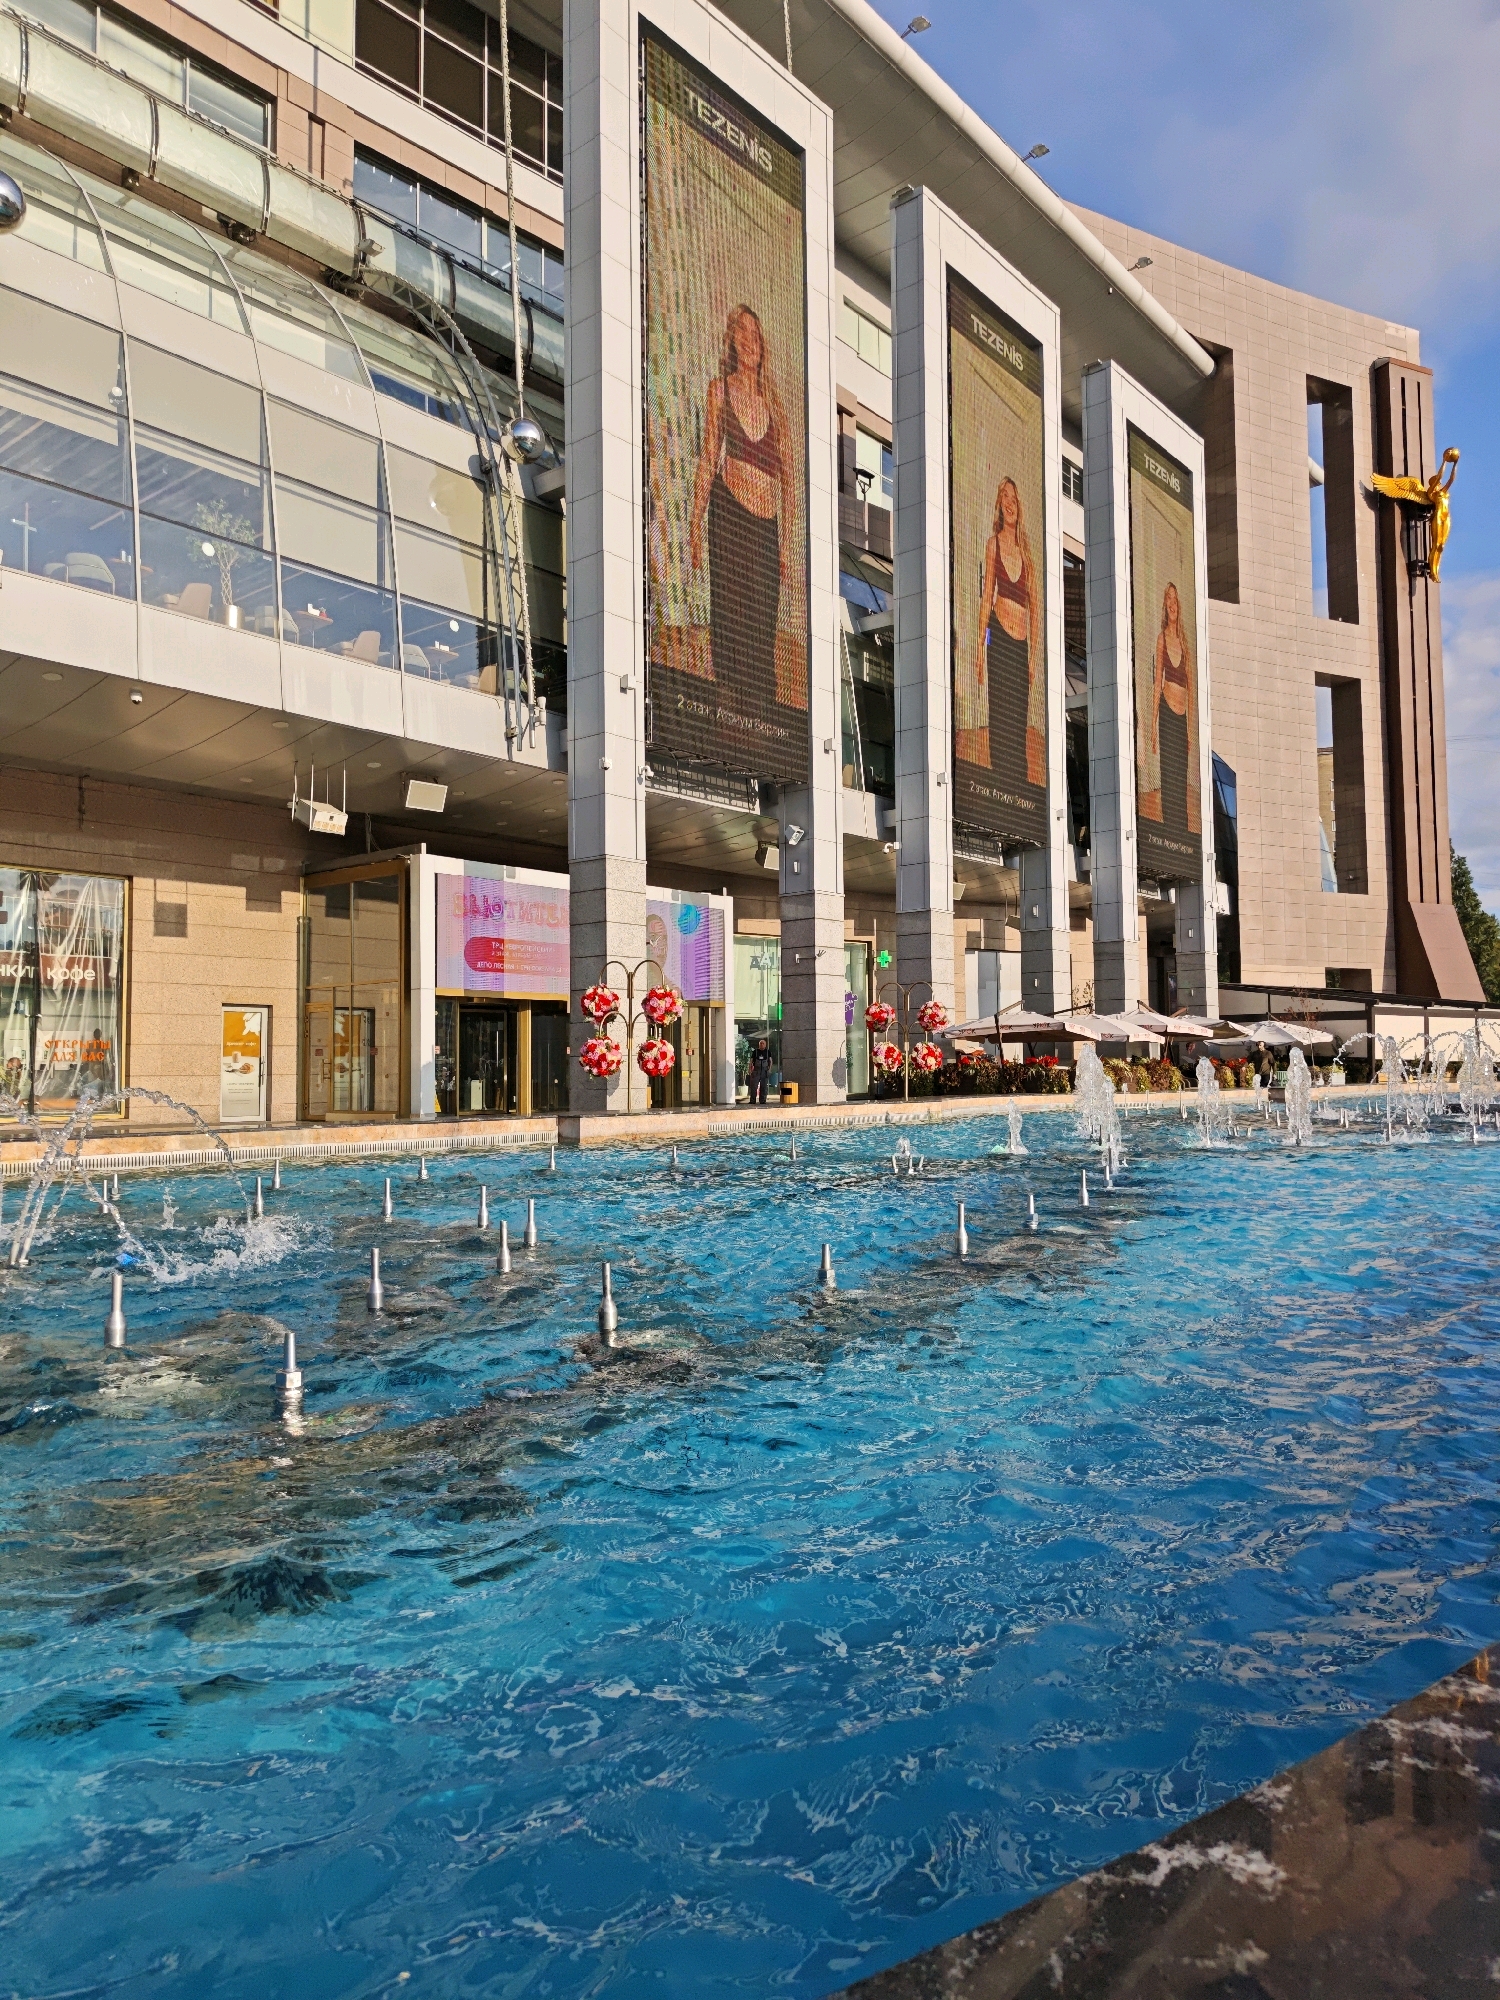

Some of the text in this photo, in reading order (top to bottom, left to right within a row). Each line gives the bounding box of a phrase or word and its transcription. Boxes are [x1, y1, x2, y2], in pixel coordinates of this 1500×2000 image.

[970, 313, 1024, 371] TEZENIS
[1143, 454, 1181, 493] TEZENIS
[677, 694, 685, 709] 2
[969, 781, 975, 792] 2
[46, 964, 96, 984] кофе
[44, 1039, 111, 1050] ОТКРЫТЫ
[51, 1051, 105, 1063] ДЛЯ ВАС
